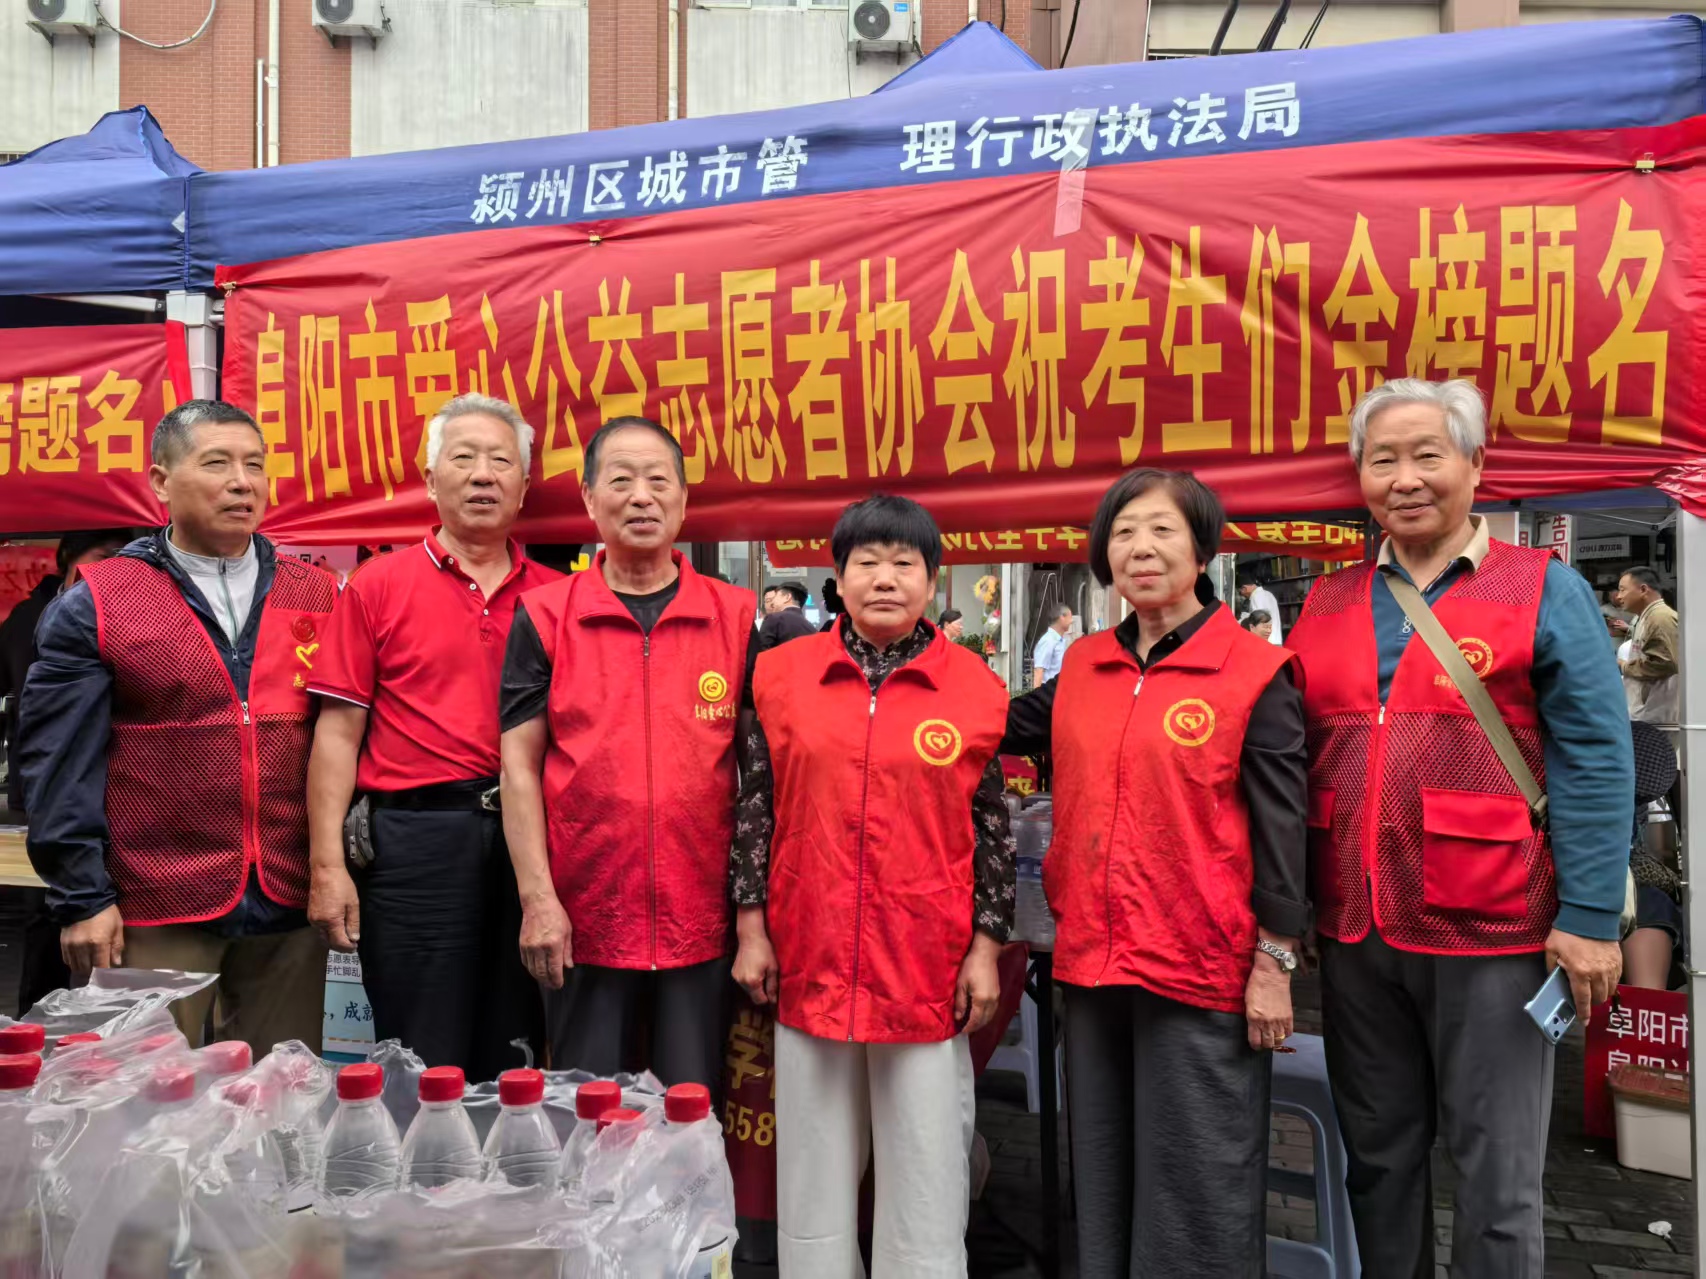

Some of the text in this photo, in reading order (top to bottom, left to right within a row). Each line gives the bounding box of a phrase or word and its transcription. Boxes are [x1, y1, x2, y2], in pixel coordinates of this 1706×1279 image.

[470, 81, 1301, 225] 颍州区城市管 理行政执法局
[0, 369, 177, 477] 题名
[323, 1001, 374, 1022] ，成就
